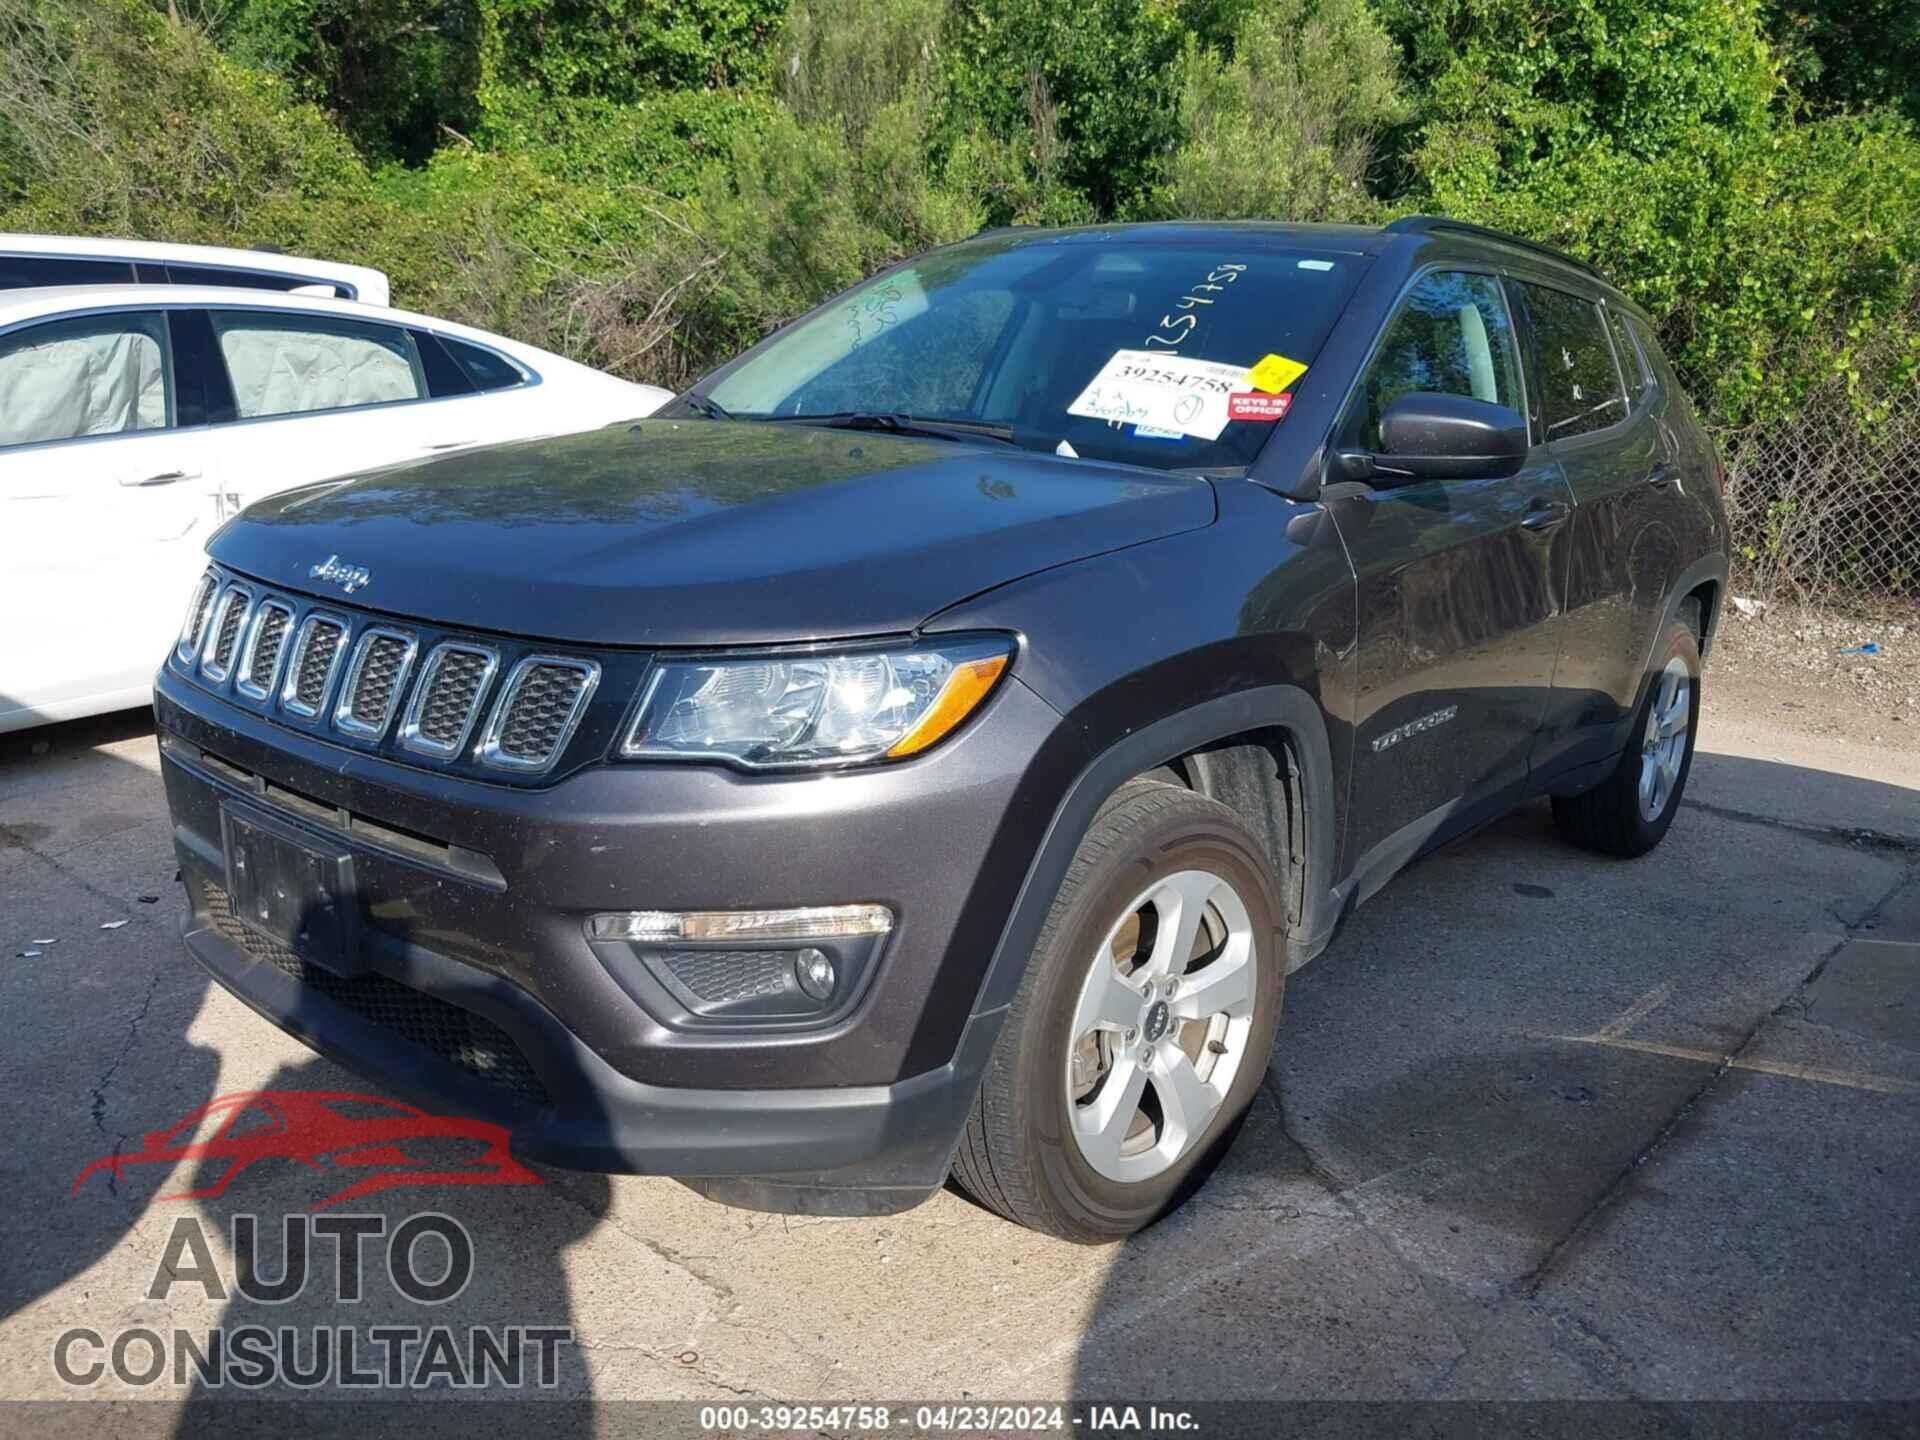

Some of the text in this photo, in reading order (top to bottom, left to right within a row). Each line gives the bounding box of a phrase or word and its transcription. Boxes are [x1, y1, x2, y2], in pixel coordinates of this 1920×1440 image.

[1115, 364, 1233, 394] 39254758
[1232, 397, 1288, 407] KEYS IN
[1234, 406, 1283, 415] OFFICE
[309, 555, 369, 593] Jeep
